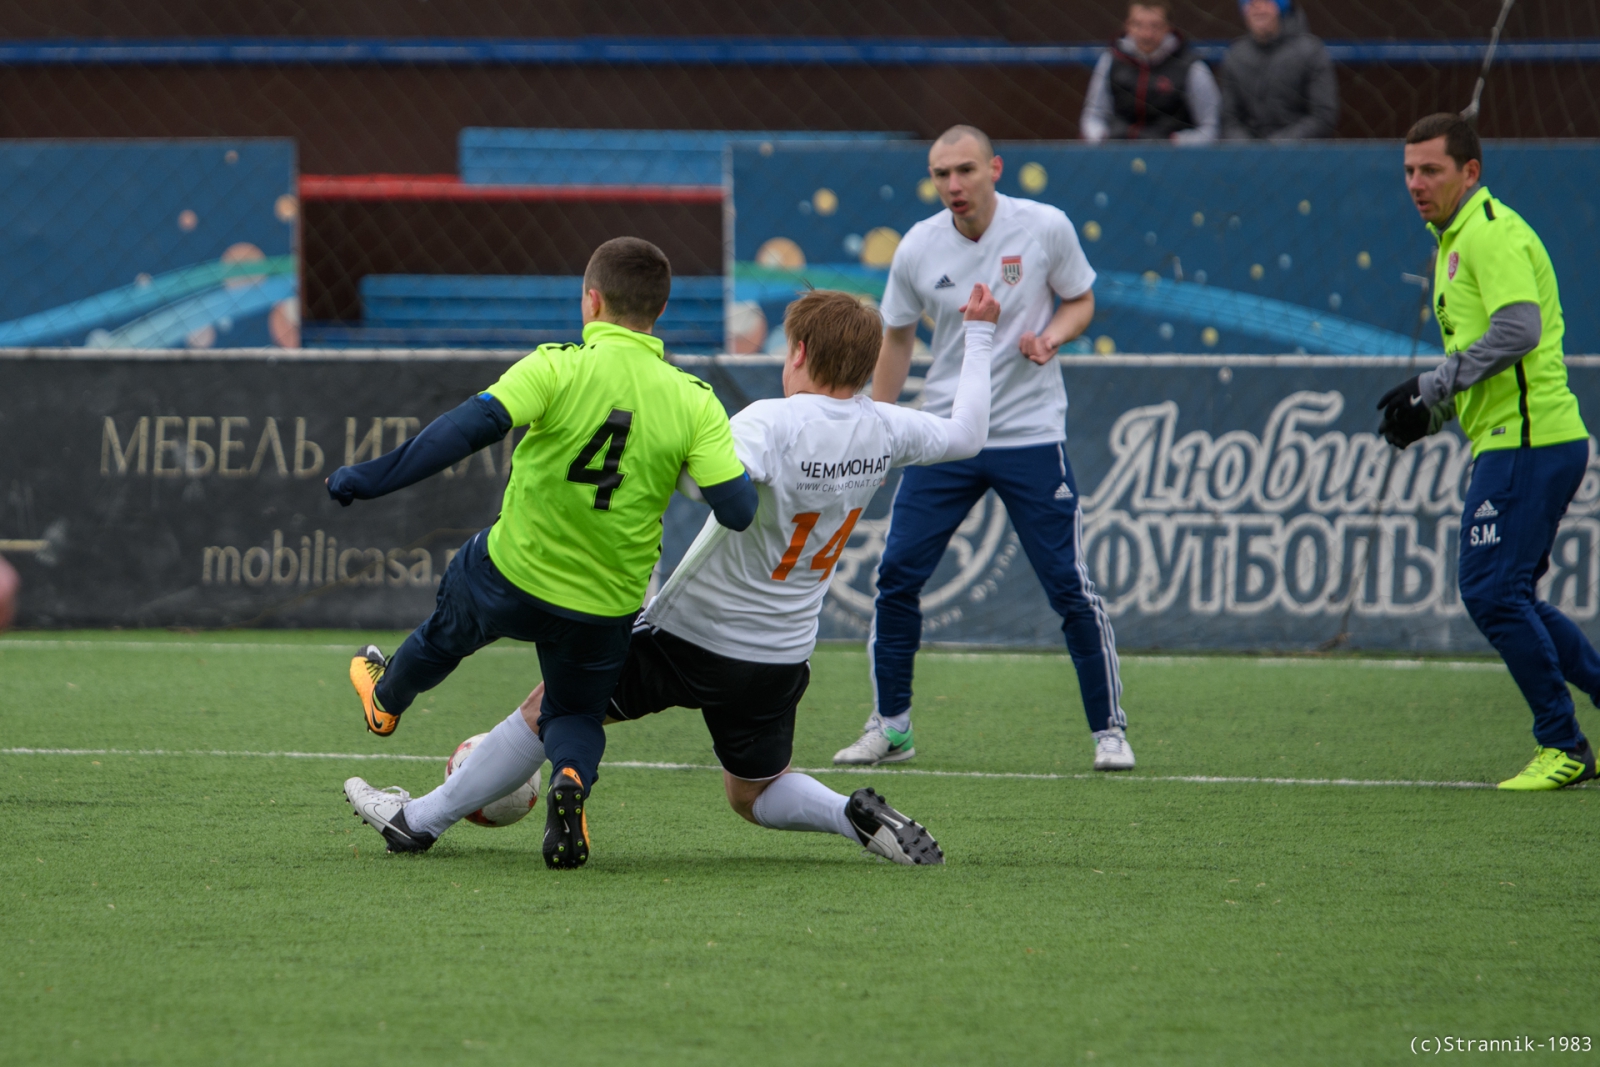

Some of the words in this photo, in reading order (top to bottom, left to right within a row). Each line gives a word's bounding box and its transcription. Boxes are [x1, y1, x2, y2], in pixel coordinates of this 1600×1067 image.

[101, 416, 325, 477] МЕБЕЛЬ
[565, 406, 635, 511] 4
[771, 507, 864, 582] 14
[1470, 523, 1501, 546] S.M.
